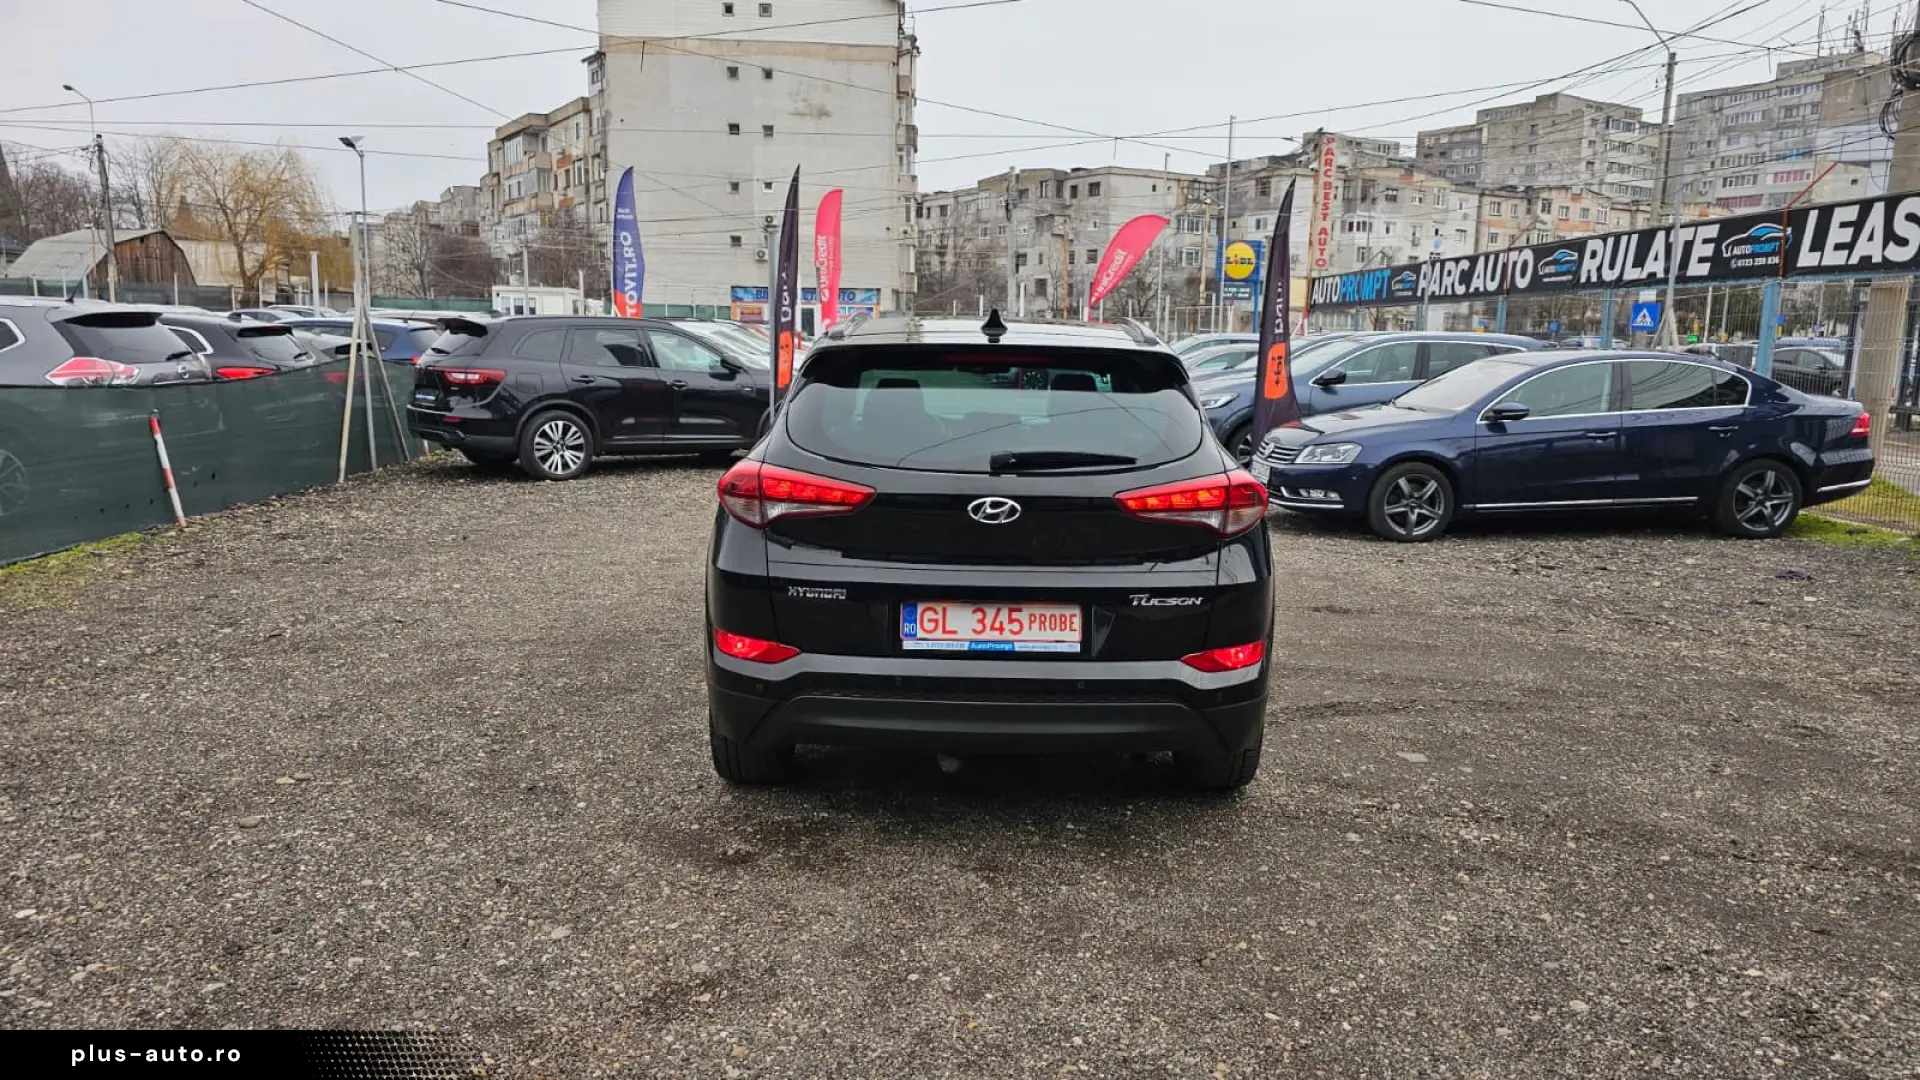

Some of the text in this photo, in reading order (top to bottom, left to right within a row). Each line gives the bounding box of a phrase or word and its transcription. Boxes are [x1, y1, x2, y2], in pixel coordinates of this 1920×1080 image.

[1315, 136, 1335, 267] PARC BEST AUTO
[1796, 196, 1920, 267] LEAS
[1579, 223, 1721, 283] RULATE
[1311, 269, 1391, 304] AUTOPROMPT
[1416, 248, 1534, 297] PARC AUTO
[788, 586, 847, 599] HYUNDAI
[1129, 594, 1204, 605] TUCSON
[904, 623, 916, 634] RO
[919, 606, 1078, 635] GL 345 PROBE
